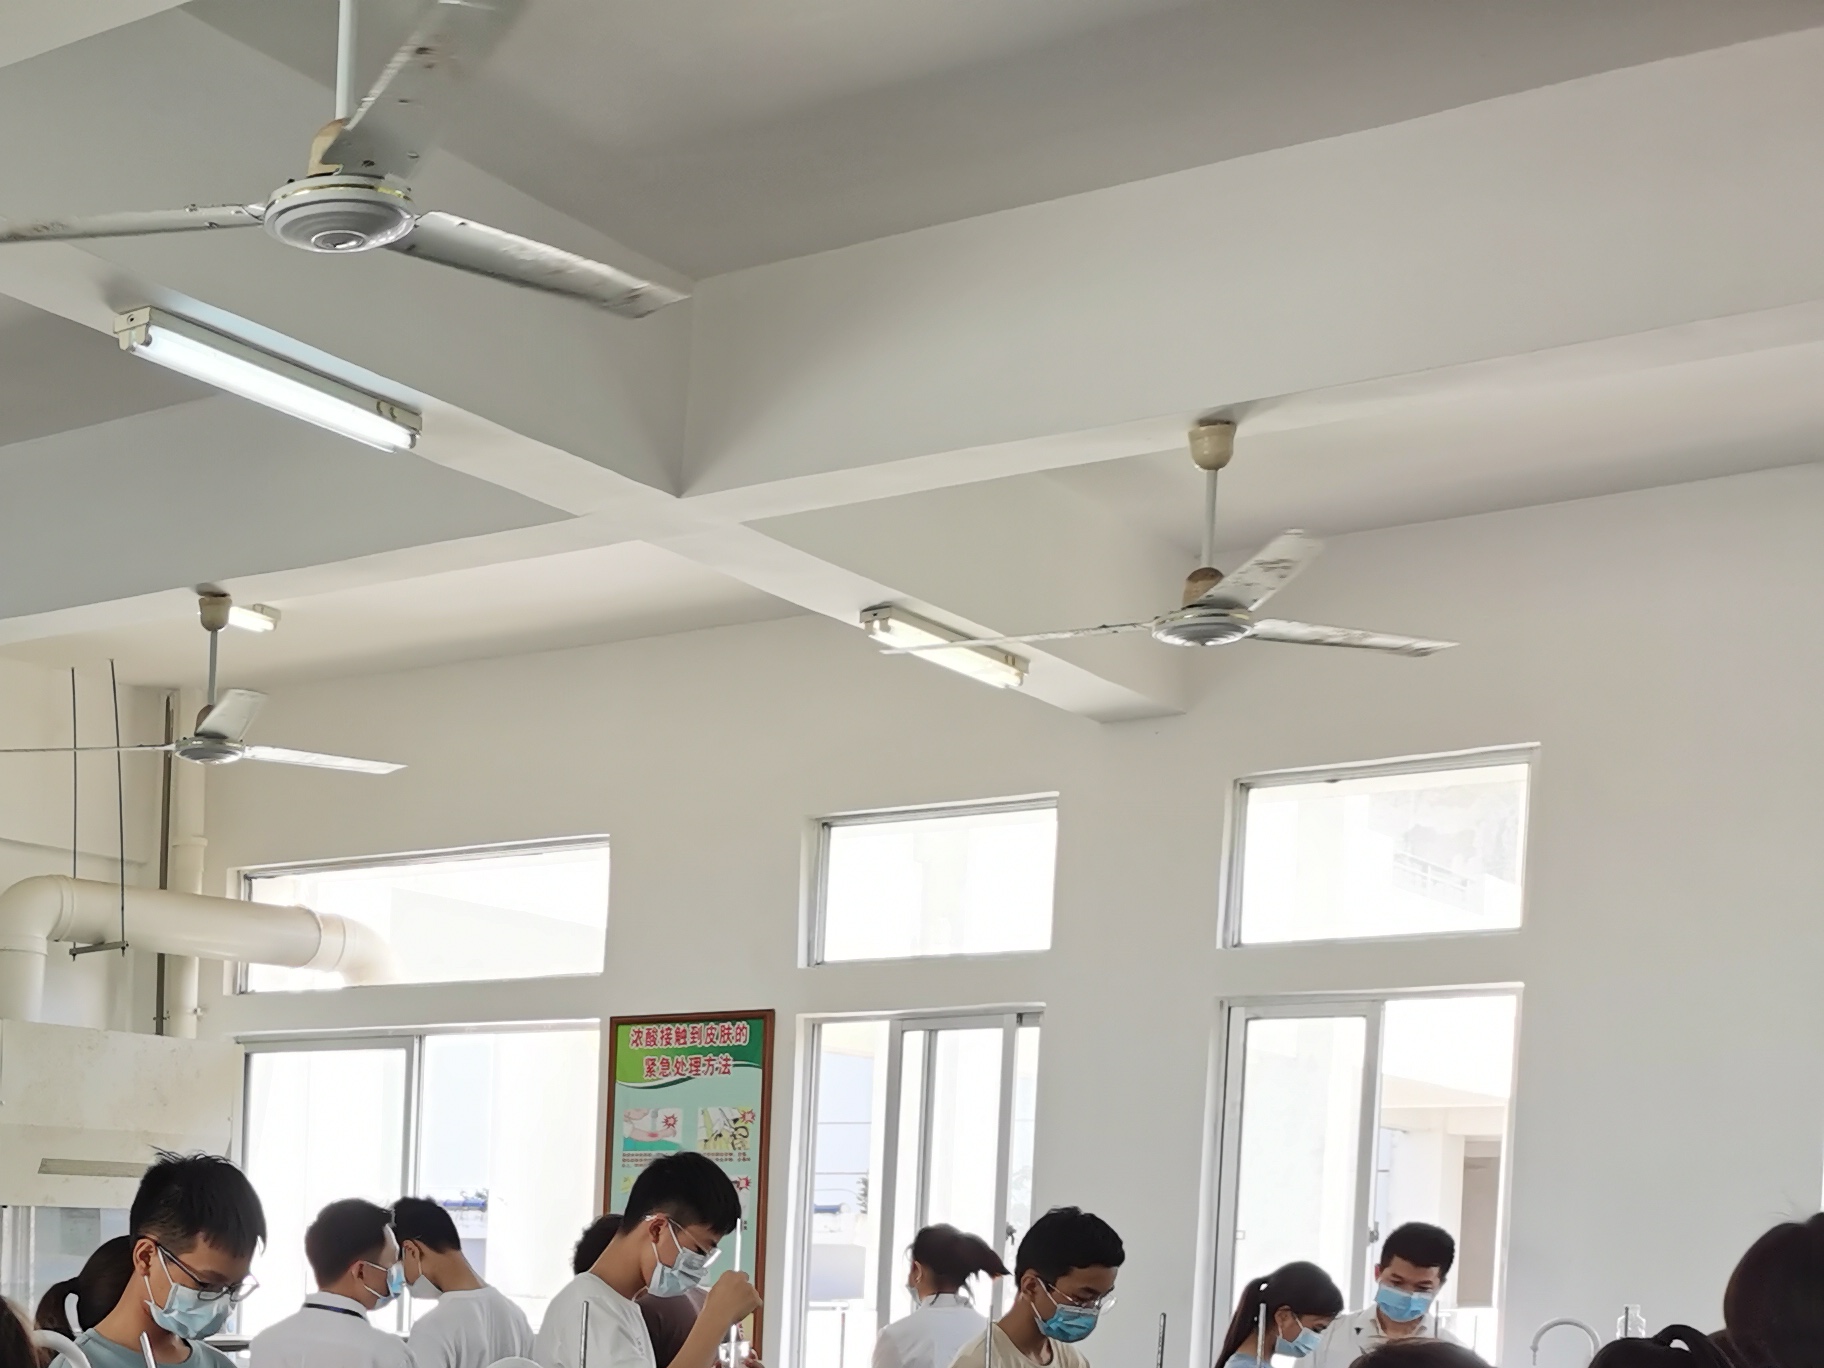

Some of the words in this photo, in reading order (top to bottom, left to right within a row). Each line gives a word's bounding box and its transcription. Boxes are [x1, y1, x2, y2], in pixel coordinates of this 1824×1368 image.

[630, 1022, 749, 1048] 浓酸接触到皮肤的
[643, 1056, 732, 1078] 紧急处理方法
